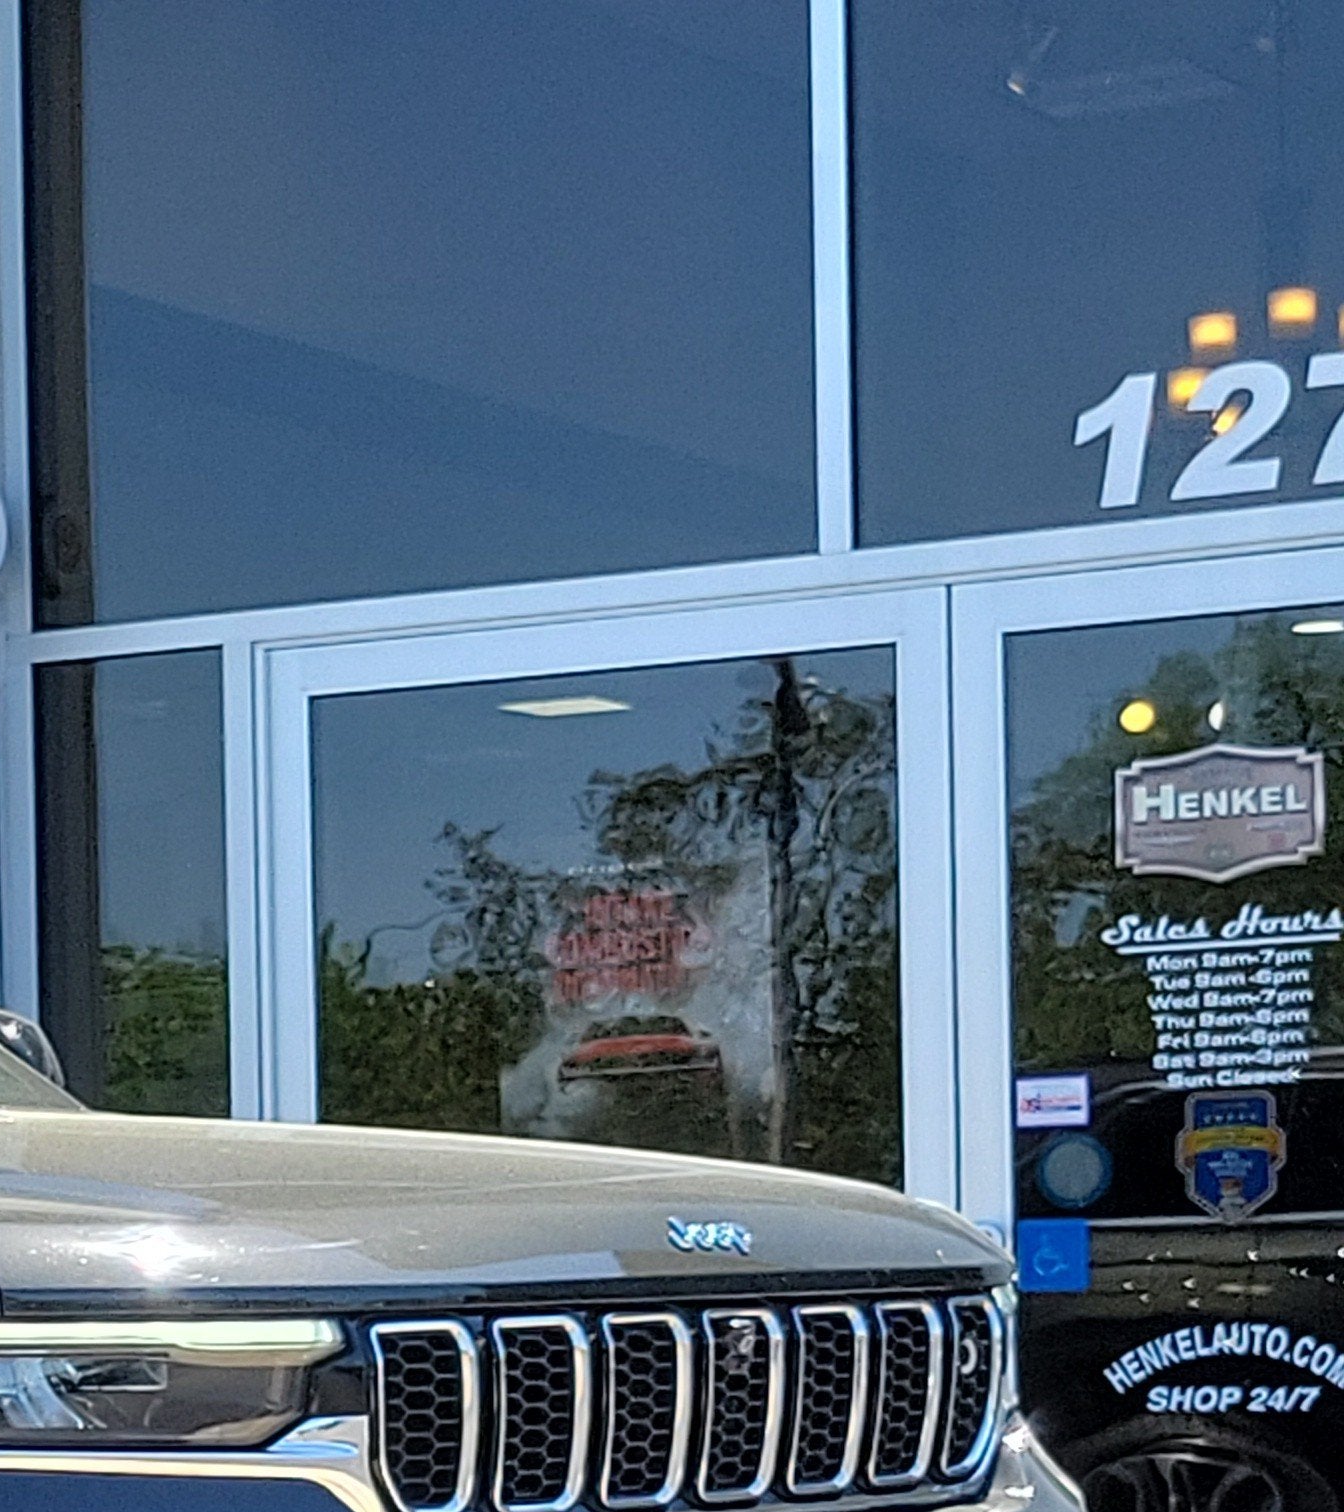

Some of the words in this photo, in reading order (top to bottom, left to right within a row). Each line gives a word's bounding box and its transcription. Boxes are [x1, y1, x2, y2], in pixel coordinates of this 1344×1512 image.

[1132, 783, 1307, 823] HENKEL
[1100, 914, 1210, 945] Sales
[1220, 902, 1344, 939] Hours
[1146, 954, 1198, 972] Mon
[1150, 974, 1190, 991] Tue
[1146, 992, 1199, 1011] Wed
[1150, 1013, 1196, 1030] Thu
[1157, 1032, 1190, 1049] Fri
[1152, 1052, 1196, 1070] Sat
[1167, 1072, 1213, 1089] Sun
[1146, 1384, 1243, 1413] SHOP
[1246, 1384, 1322, 1413] 24/7
